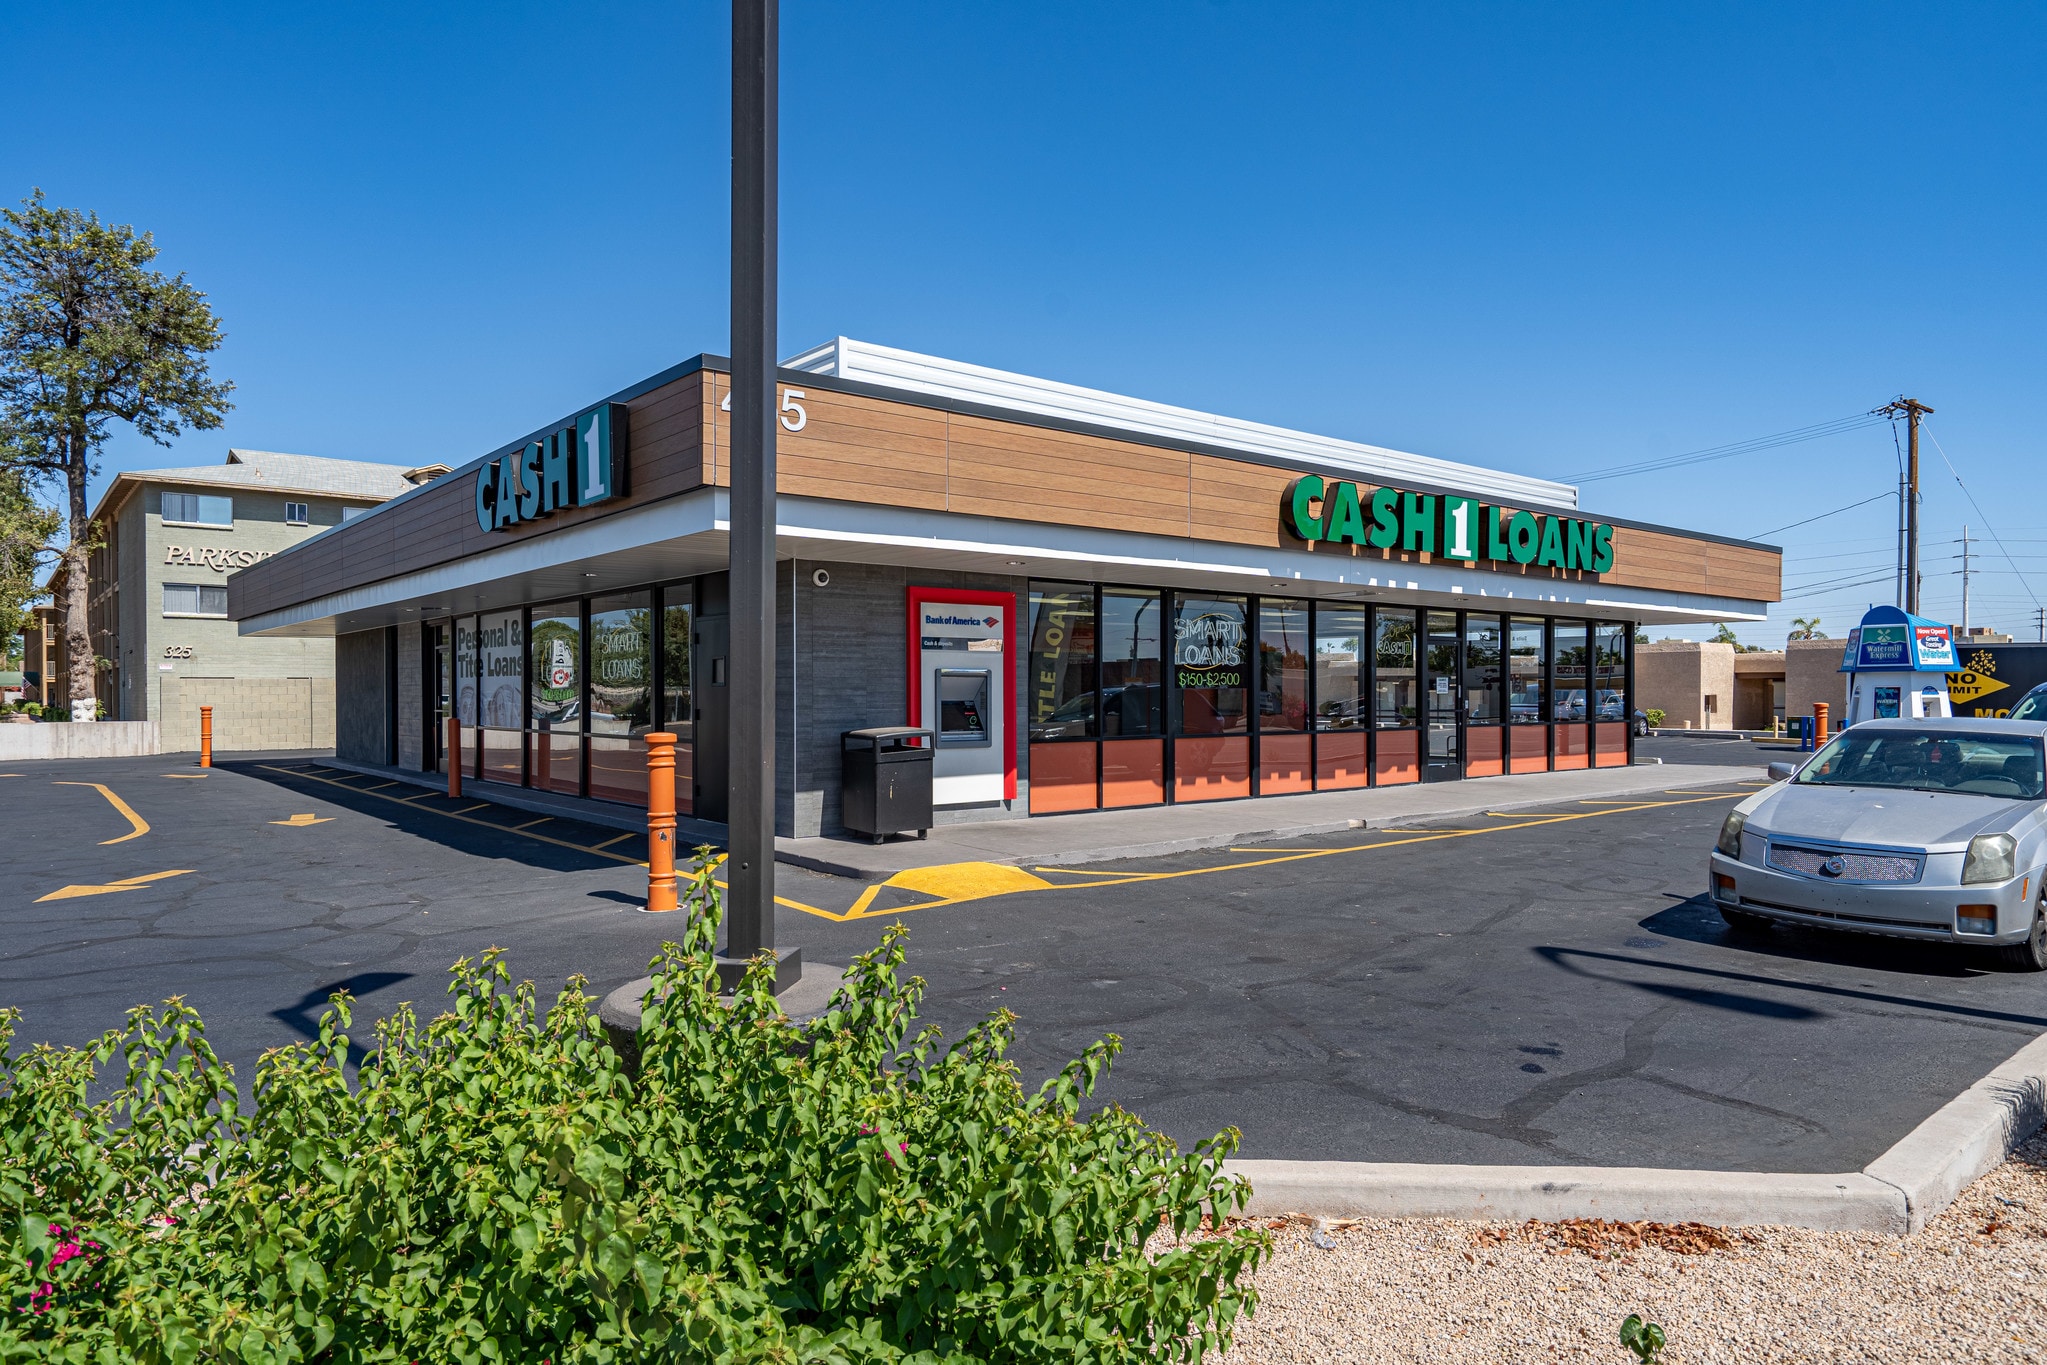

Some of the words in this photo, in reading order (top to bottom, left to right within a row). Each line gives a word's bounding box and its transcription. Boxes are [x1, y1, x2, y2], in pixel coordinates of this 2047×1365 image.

[475, 428, 571, 533] CASH
[582, 411, 606, 501] 1
[1291, 474, 1435, 553] CASH
[1449, 499, 1473, 559] 1
[1488, 505, 1614, 573] LOANS
[165, 546, 276, 572] PARKSI
[925, 615, 944, 624] Bank
[944, 616, 953, 625] of
[952, 616, 981, 626] America
[1175, 618, 1242, 640] SMART
[458, 619, 508, 651] Personal
[1388, 623, 1410, 637] Open
[1930, 628, 1947, 636] Open!
[602, 631, 642, 654] SMART
[1377, 641, 1404, 655] CASH
[164, 645, 192, 659] 325
[1175, 645, 1241, 667] LOANS
[1919, 649, 1950, 659] Water
[458, 653, 483, 678] Tite
[488, 652, 523, 677] Loans
[602, 658, 641, 679] LOANS
[1179, 672, 1240, 687] $150-$2,500
[1945, 673, 1977, 684] NO
[1948, 686, 1982, 694] IMIT
